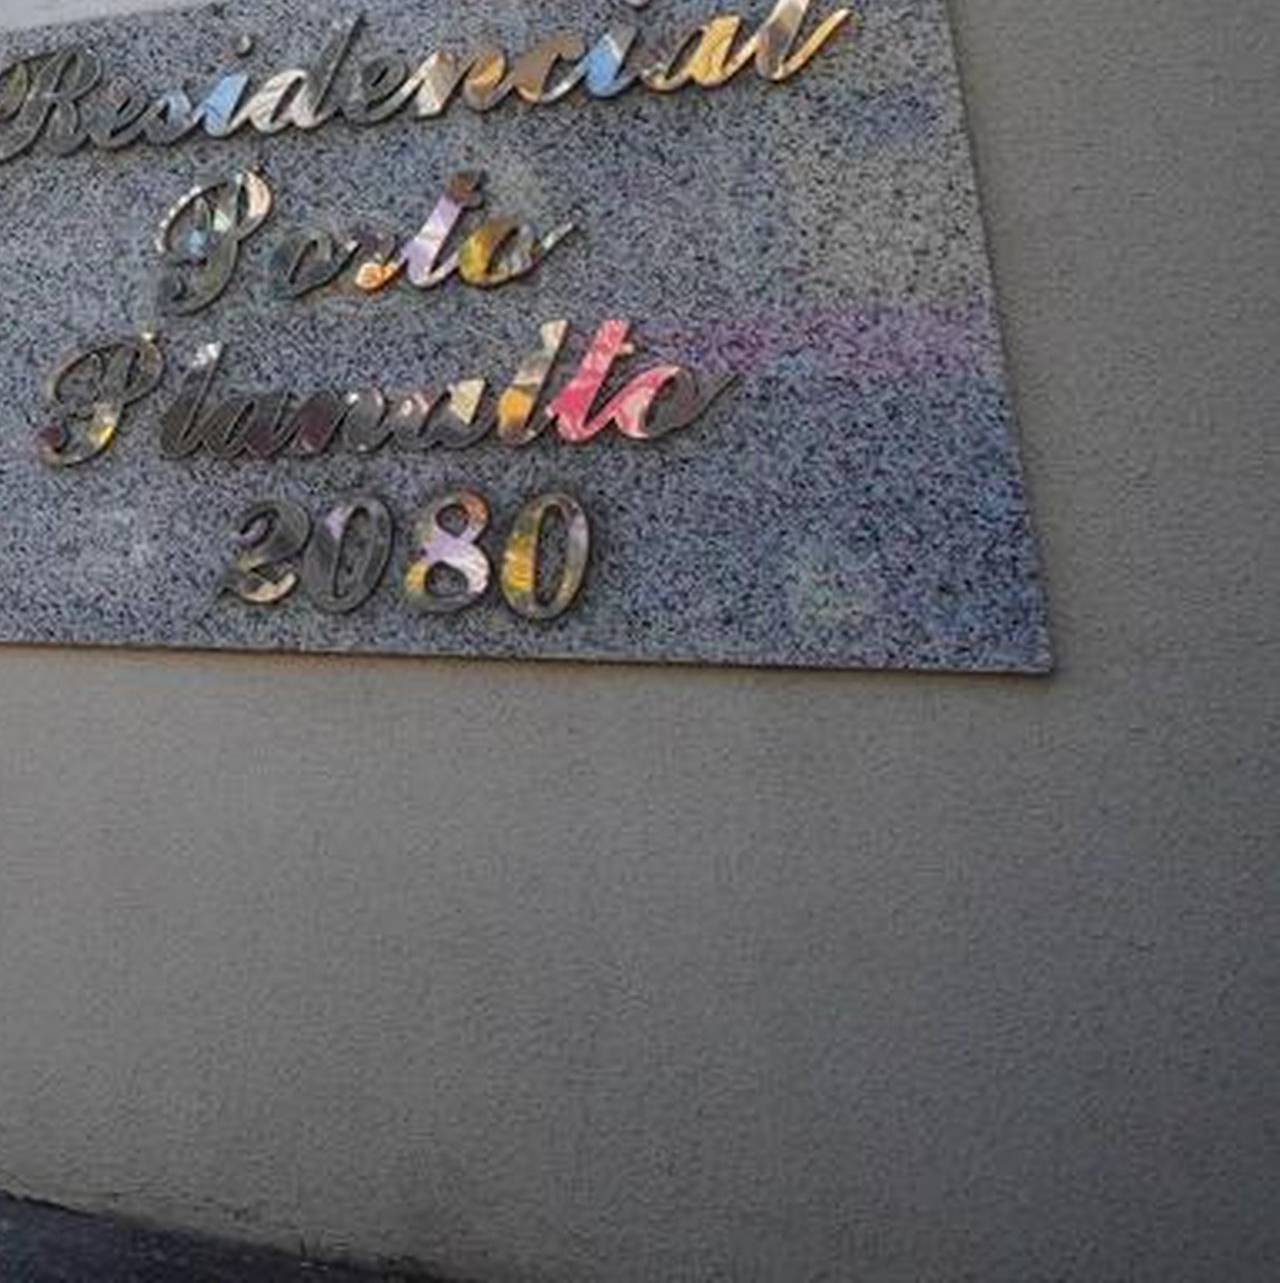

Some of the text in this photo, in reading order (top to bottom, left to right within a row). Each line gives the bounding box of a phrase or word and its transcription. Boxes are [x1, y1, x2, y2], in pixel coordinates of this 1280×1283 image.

[154, 164, 581, 316] Porto
[38, 316, 740, 468] Planalto
[216, 490, 592, 622] 2080
